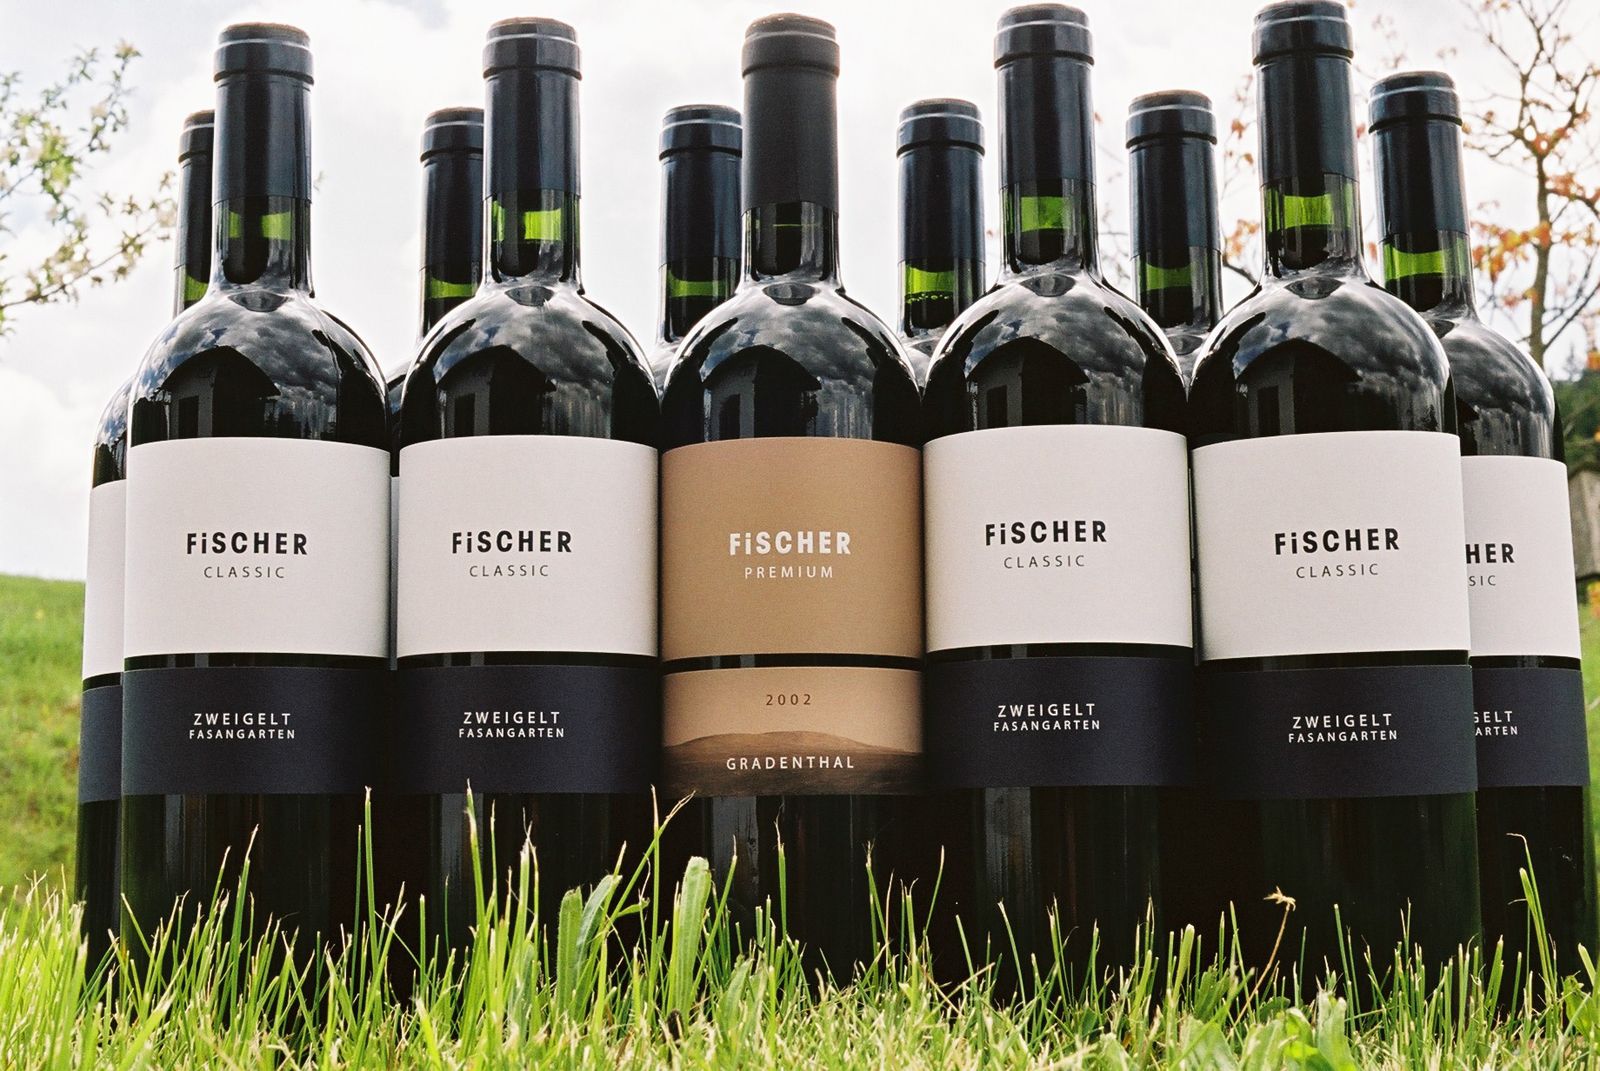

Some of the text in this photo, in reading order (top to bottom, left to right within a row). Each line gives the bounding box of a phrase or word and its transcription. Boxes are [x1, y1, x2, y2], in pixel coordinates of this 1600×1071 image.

[986, 521, 1106, 546] FiSCHER
[187, 532, 307, 555] FiSCHER
[453, 531, 571, 553] FiSCHER
[730, 531, 850, 555] FiSCHER
[1275, 529, 1399, 555] FiSCHER
[1004, 555, 1085, 569] CLASSIC
[204, 567, 284, 578] CLASSIC
[470, 565, 549, 577] CLASSIC
[745, 566, 832, 579] PREMIUM
[1296, 564, 1378, 578] CLASSIC
[766, 694, 810, 705] 2002
[998, 704, 1094, 717] ZWEIGELT
[194, 713, 290, 725] ZWEIGELT
[464, 712, 559, 724] ZWEIGELT
[1293, 714, 1391, 728] ZWEIGELT
[994, 720, 1099, 731] FASANGARTEN
[190, 729, 294, 739] FASANGARTEN
[459, 728, 563, 737] FASANGARTEN
[1289, 729, 1396, 742] FASANGARTEN
[727, 756, 853, 769] GRADENTHAL
